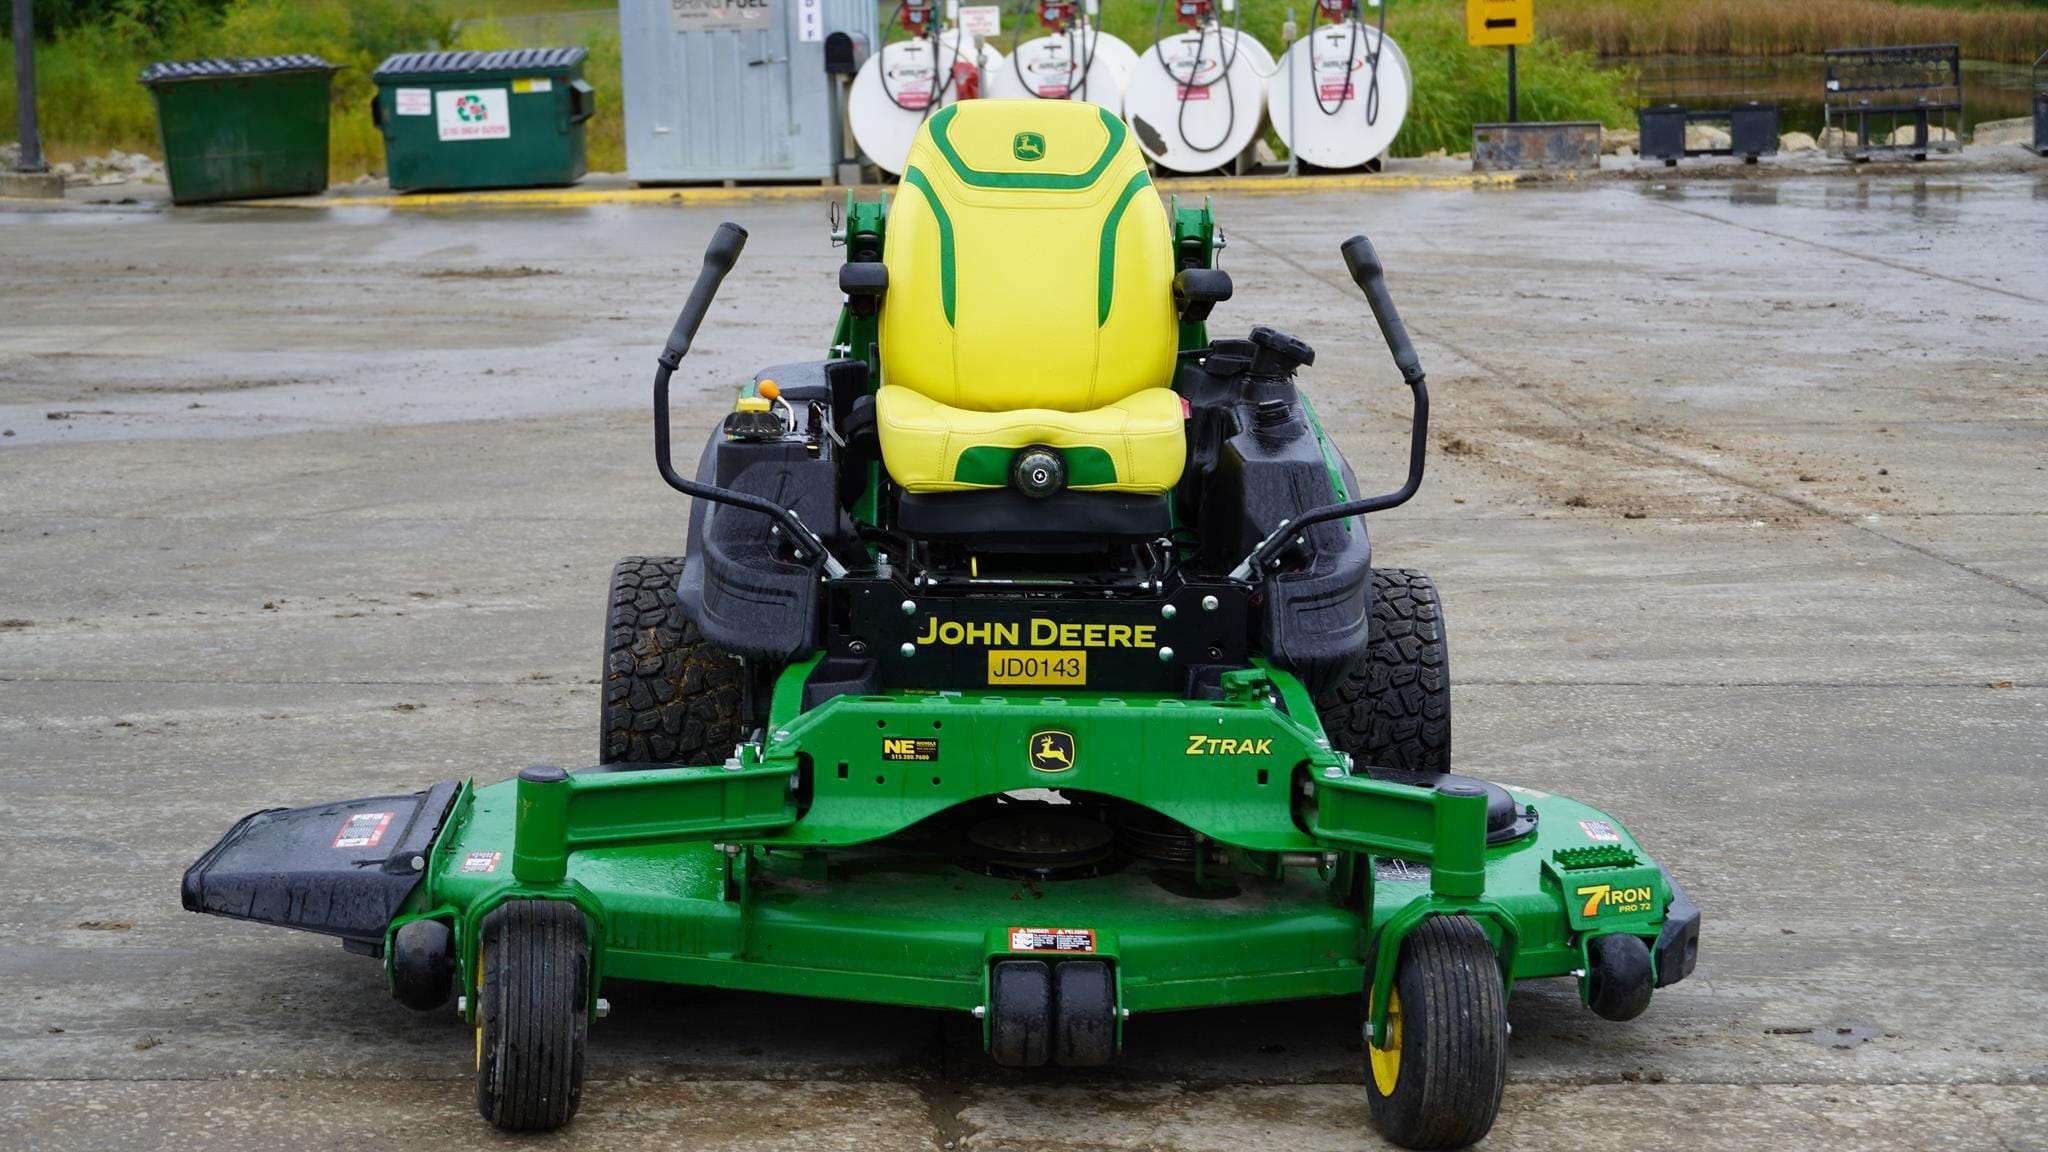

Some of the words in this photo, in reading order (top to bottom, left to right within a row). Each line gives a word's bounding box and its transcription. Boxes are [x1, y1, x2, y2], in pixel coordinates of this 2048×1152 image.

[673, 0, 721, 9] BRING
[725, 0, 768, 8] FUEL
[917, 616, 1019, 646] JOHN
[1030, 618, 1157, 648] DEERE
[993, 658, 1080, 678] JD0143
[884, 739, 915, 754] NE
[1185, 735, 1273, 756] ZTRAK
[1618, 904, 1638, 912] PRO
[1640, 903, 1651, 911] 72
